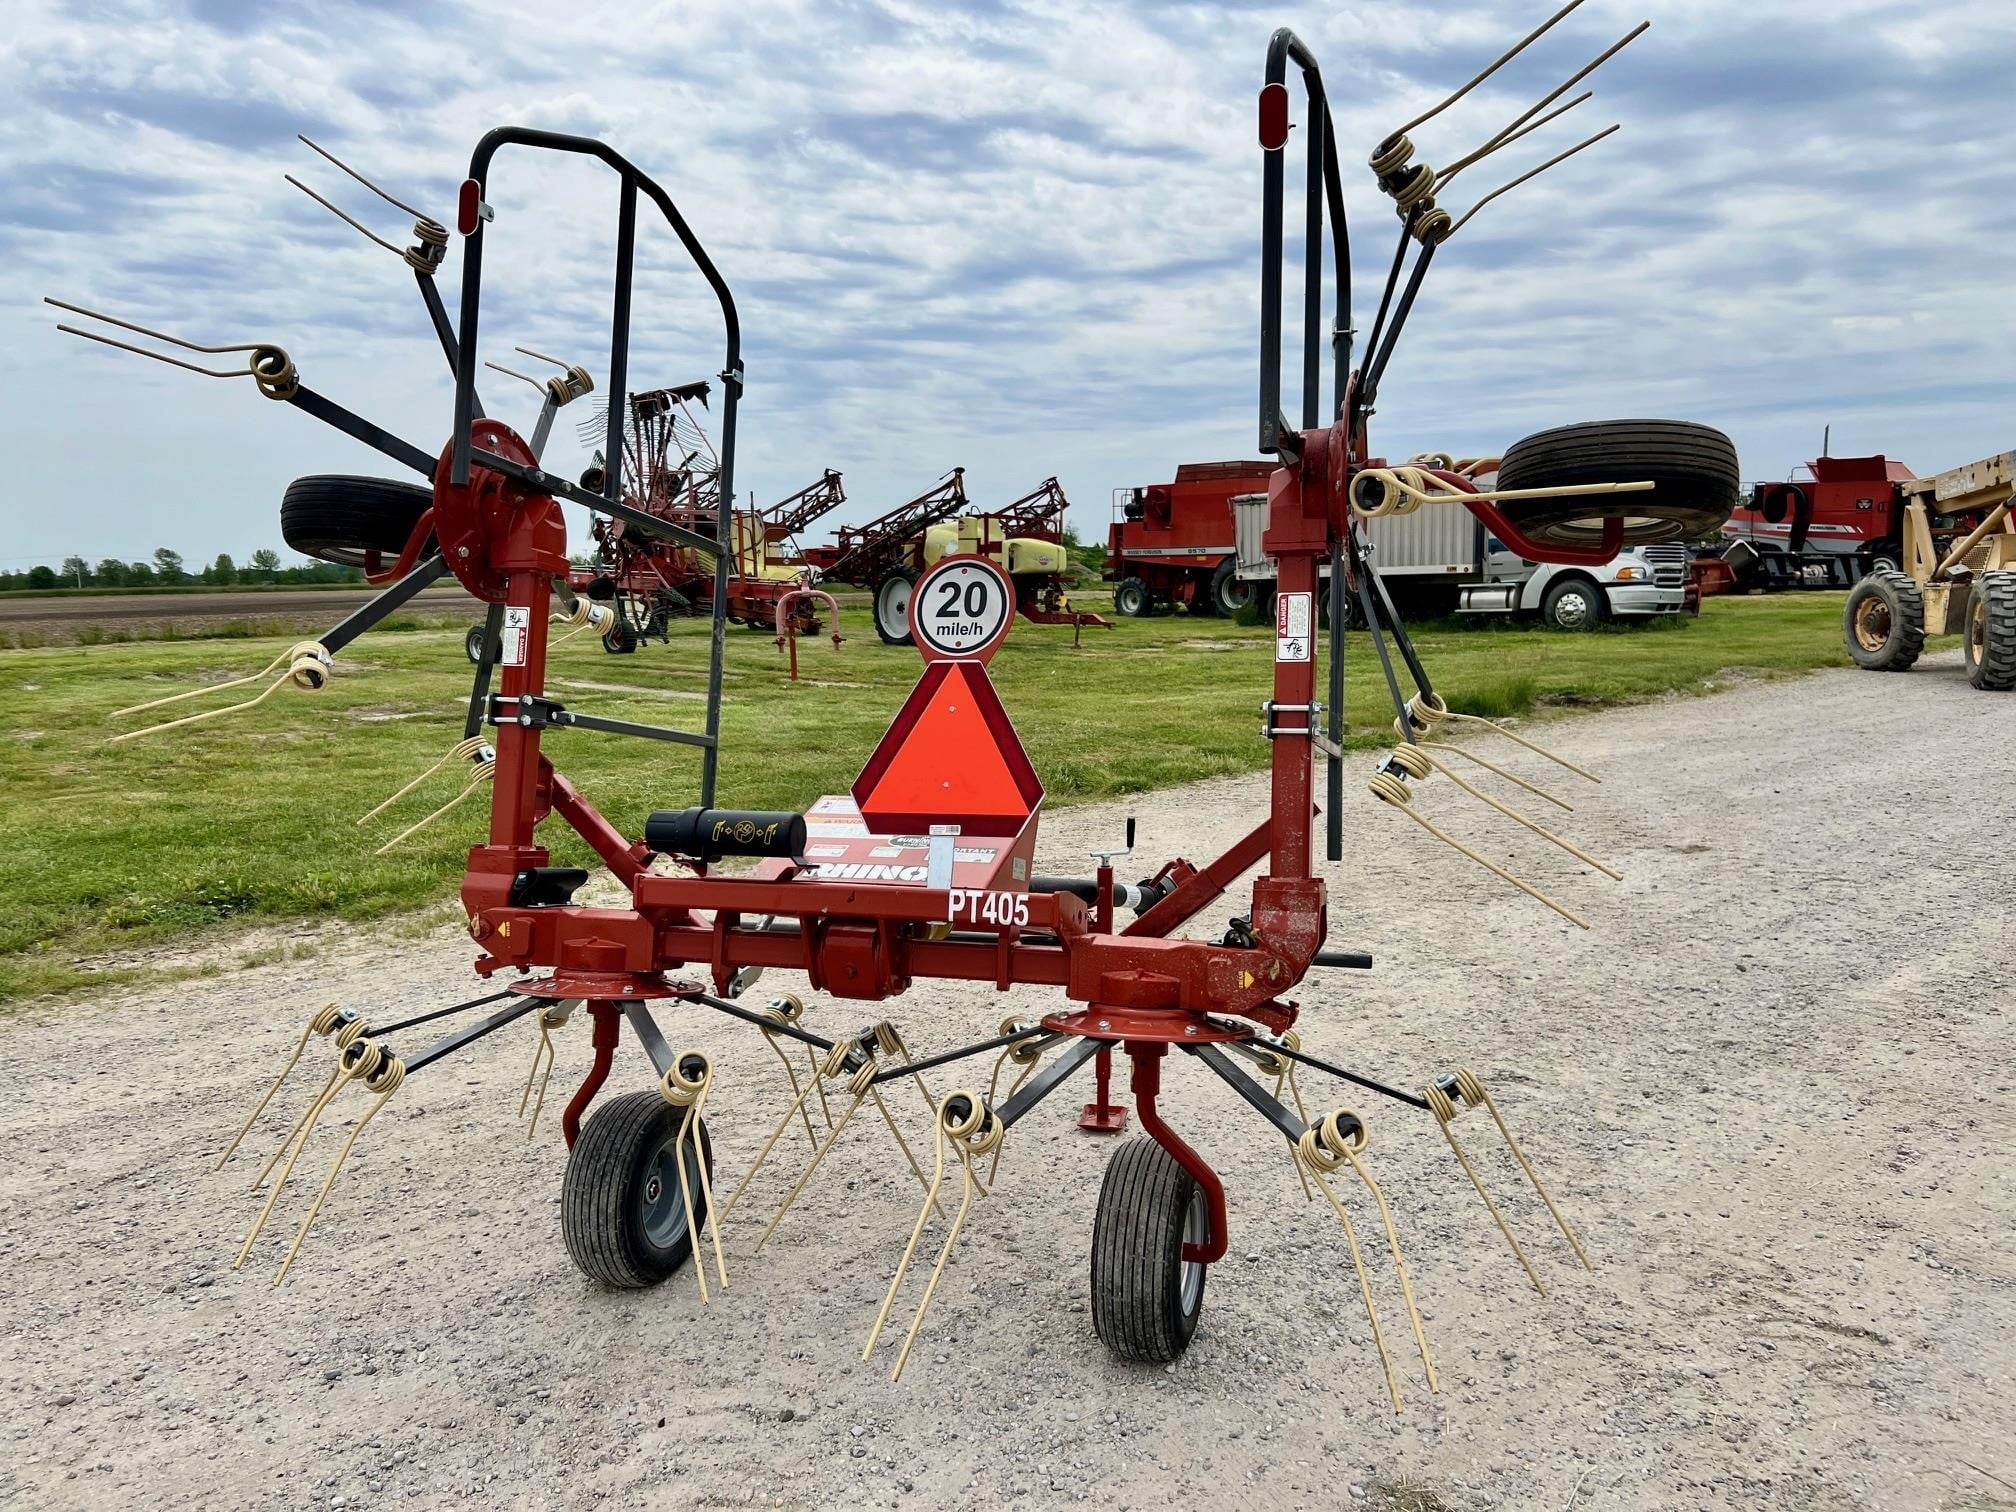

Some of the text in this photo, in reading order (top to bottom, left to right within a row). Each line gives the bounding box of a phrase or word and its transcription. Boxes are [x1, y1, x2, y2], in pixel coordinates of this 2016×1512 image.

[935, 581, 988, 618] 20
[936, 622, 983, 636] mile/h
[948, 890, 1030, 926] PT405
